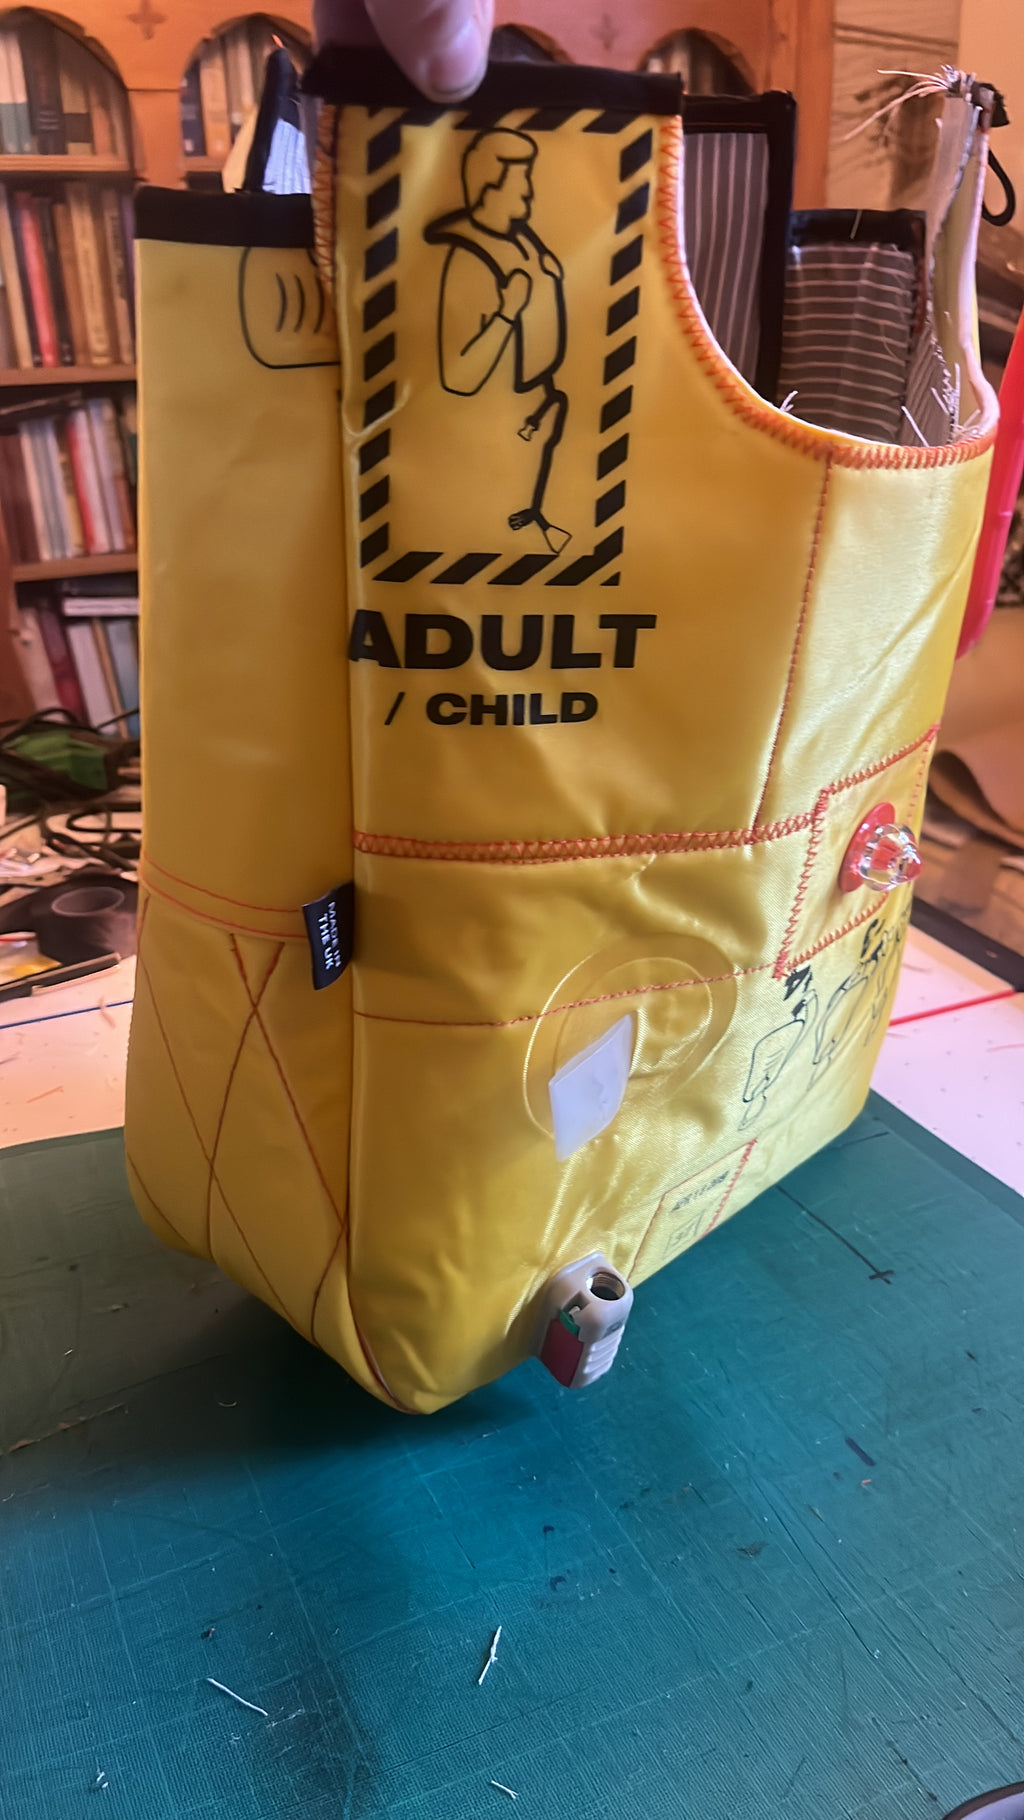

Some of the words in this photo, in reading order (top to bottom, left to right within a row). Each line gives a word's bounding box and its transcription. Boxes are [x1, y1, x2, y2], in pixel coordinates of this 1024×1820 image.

[348, 609, 657, 671] ADULT
[384, 691, 405, 726] /
[426, 692, 598, 726] CHILD
[318, 913, 330, 945] THE
[324, 947, 334, 970] UK
[328, 902, 339, 948] MADE
[334, 951, 341, 968] IN
